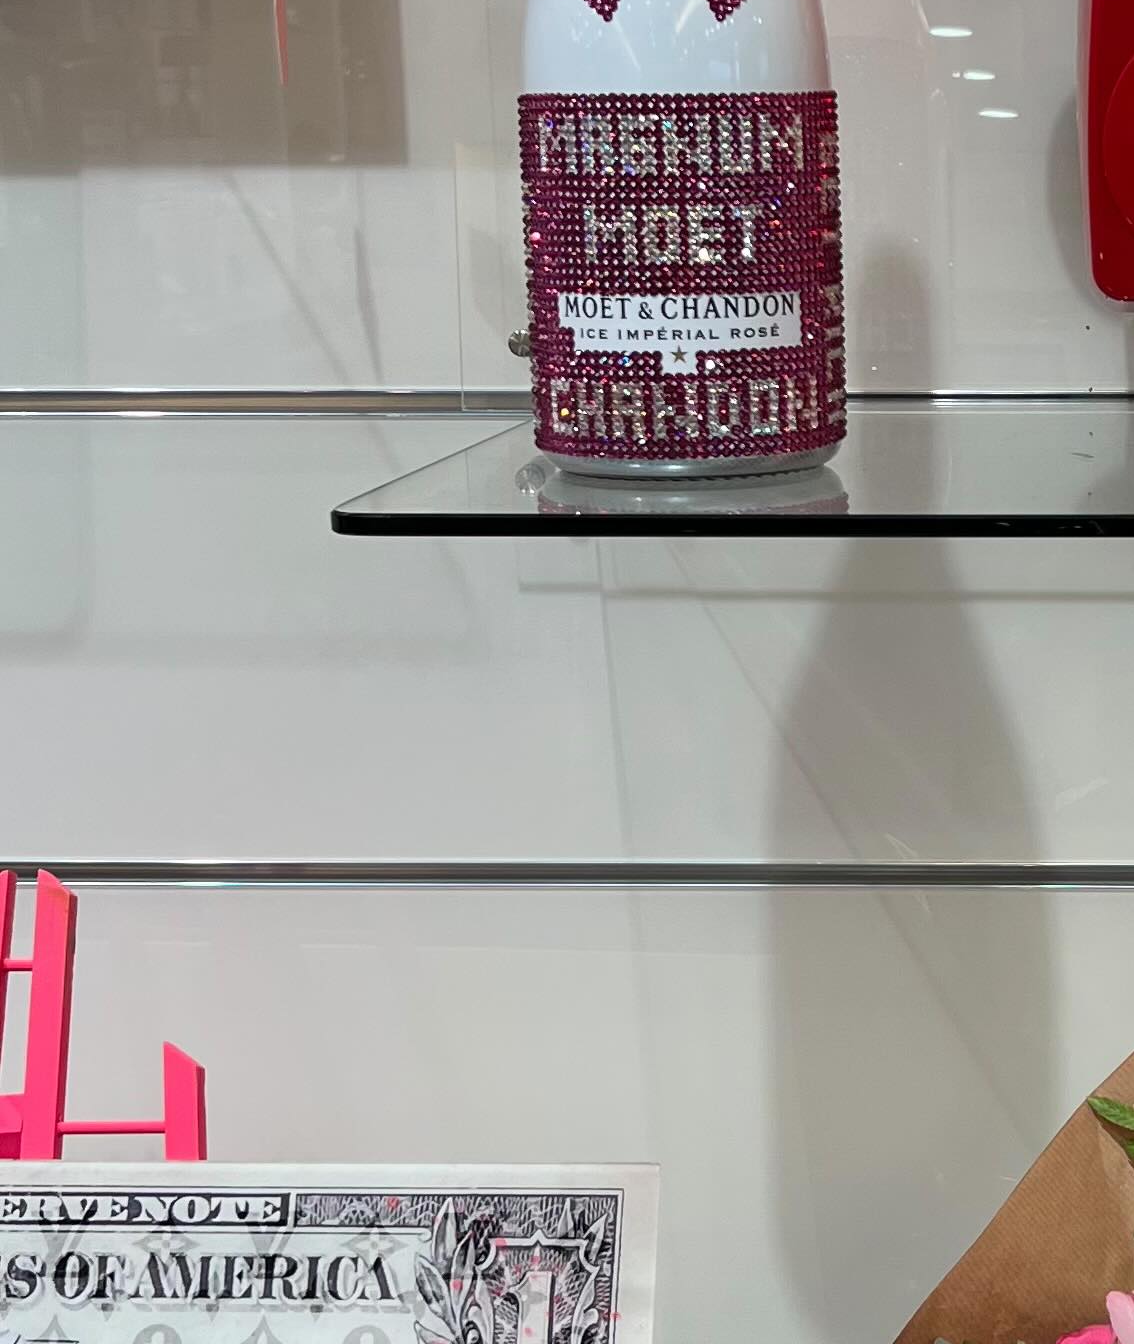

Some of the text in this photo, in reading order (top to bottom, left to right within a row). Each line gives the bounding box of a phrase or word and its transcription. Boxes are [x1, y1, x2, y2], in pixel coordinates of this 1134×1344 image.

[638, 302, 654, 320] &
[661, 294, 796, 320] CHANDON
[581, 323, 781, 341] ICE IMPÉRIAL ROSÉ
[130, 1193, 284, 1225] NOTE
[123, 1252, 405, 1304] AMERICA
